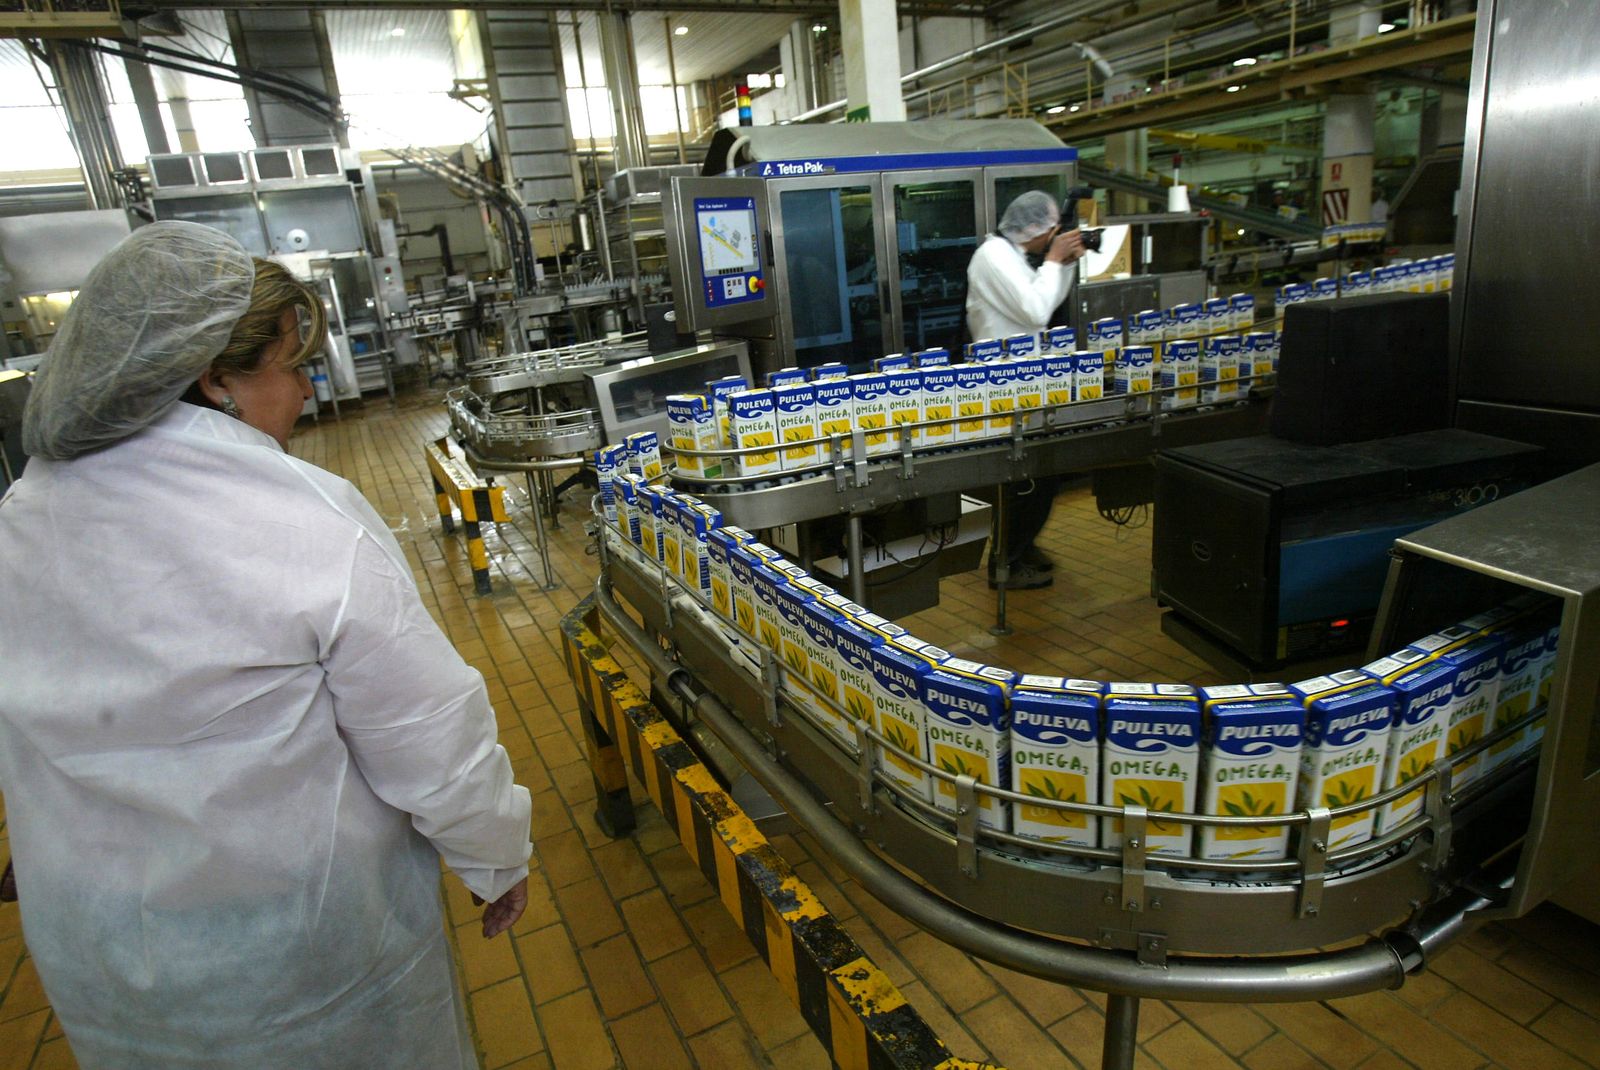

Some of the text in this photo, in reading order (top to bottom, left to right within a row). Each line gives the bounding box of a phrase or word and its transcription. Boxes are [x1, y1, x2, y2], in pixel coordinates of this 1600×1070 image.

[777, 161, 824, 175] Tetra Pak
[920, 356, 948, 366] PULEVA
[1079, 357, 1103, 367] PULEVA
[1131, 352, 1153, 361] PULEVA
[989, 369, 1016, 378] PULEVA
[1016, 365, 1043, 375] PULEVA
[1046, 361, 1071, 371] PULEVA
[889, 378, 920, 388] PULEVA
[924, 375, 954, 385] PULEVA
[957, 372, 985, 382] PULEVA
[715, 384, 747, 396] PULEVA
[818, 387, 850, 398] PULEVA
[855, 382, 886, 393] PULEVA
[736, 398, 772, 411] PULEVA
[779, 393, 813, 405] PULEVA
[668, 405, 691, 415] PULEVA
[753, 575, 777, 598] PULEVA
[777, 595, 804, 618] PULEVA
[804, 614, 833, 640] PULEVA
[837, 634, 872, 661] PULEVA
[874, 660, 916, 690] PULEVA
[1455, 657, 1498, 687] PULEVA
[927, 688, 989, 717] PULEVA
[1408, 683, 1453, 714] PULEVA
[1013, 710, 1091, 732] PULEVA
[1327, 706, 1389, 735] PULEVA
[1111, 720, 1193, 737] PULEVA
[1220, 723, 1300, 740] PULEVA
[930, 727, 990, 758] OMEGA3
[1014, 751, 1089, 776] OMEGA3
[1110, 761, 1188, 781] OMEGA3
[1216, 763, 1291, 782] OMEGA3
